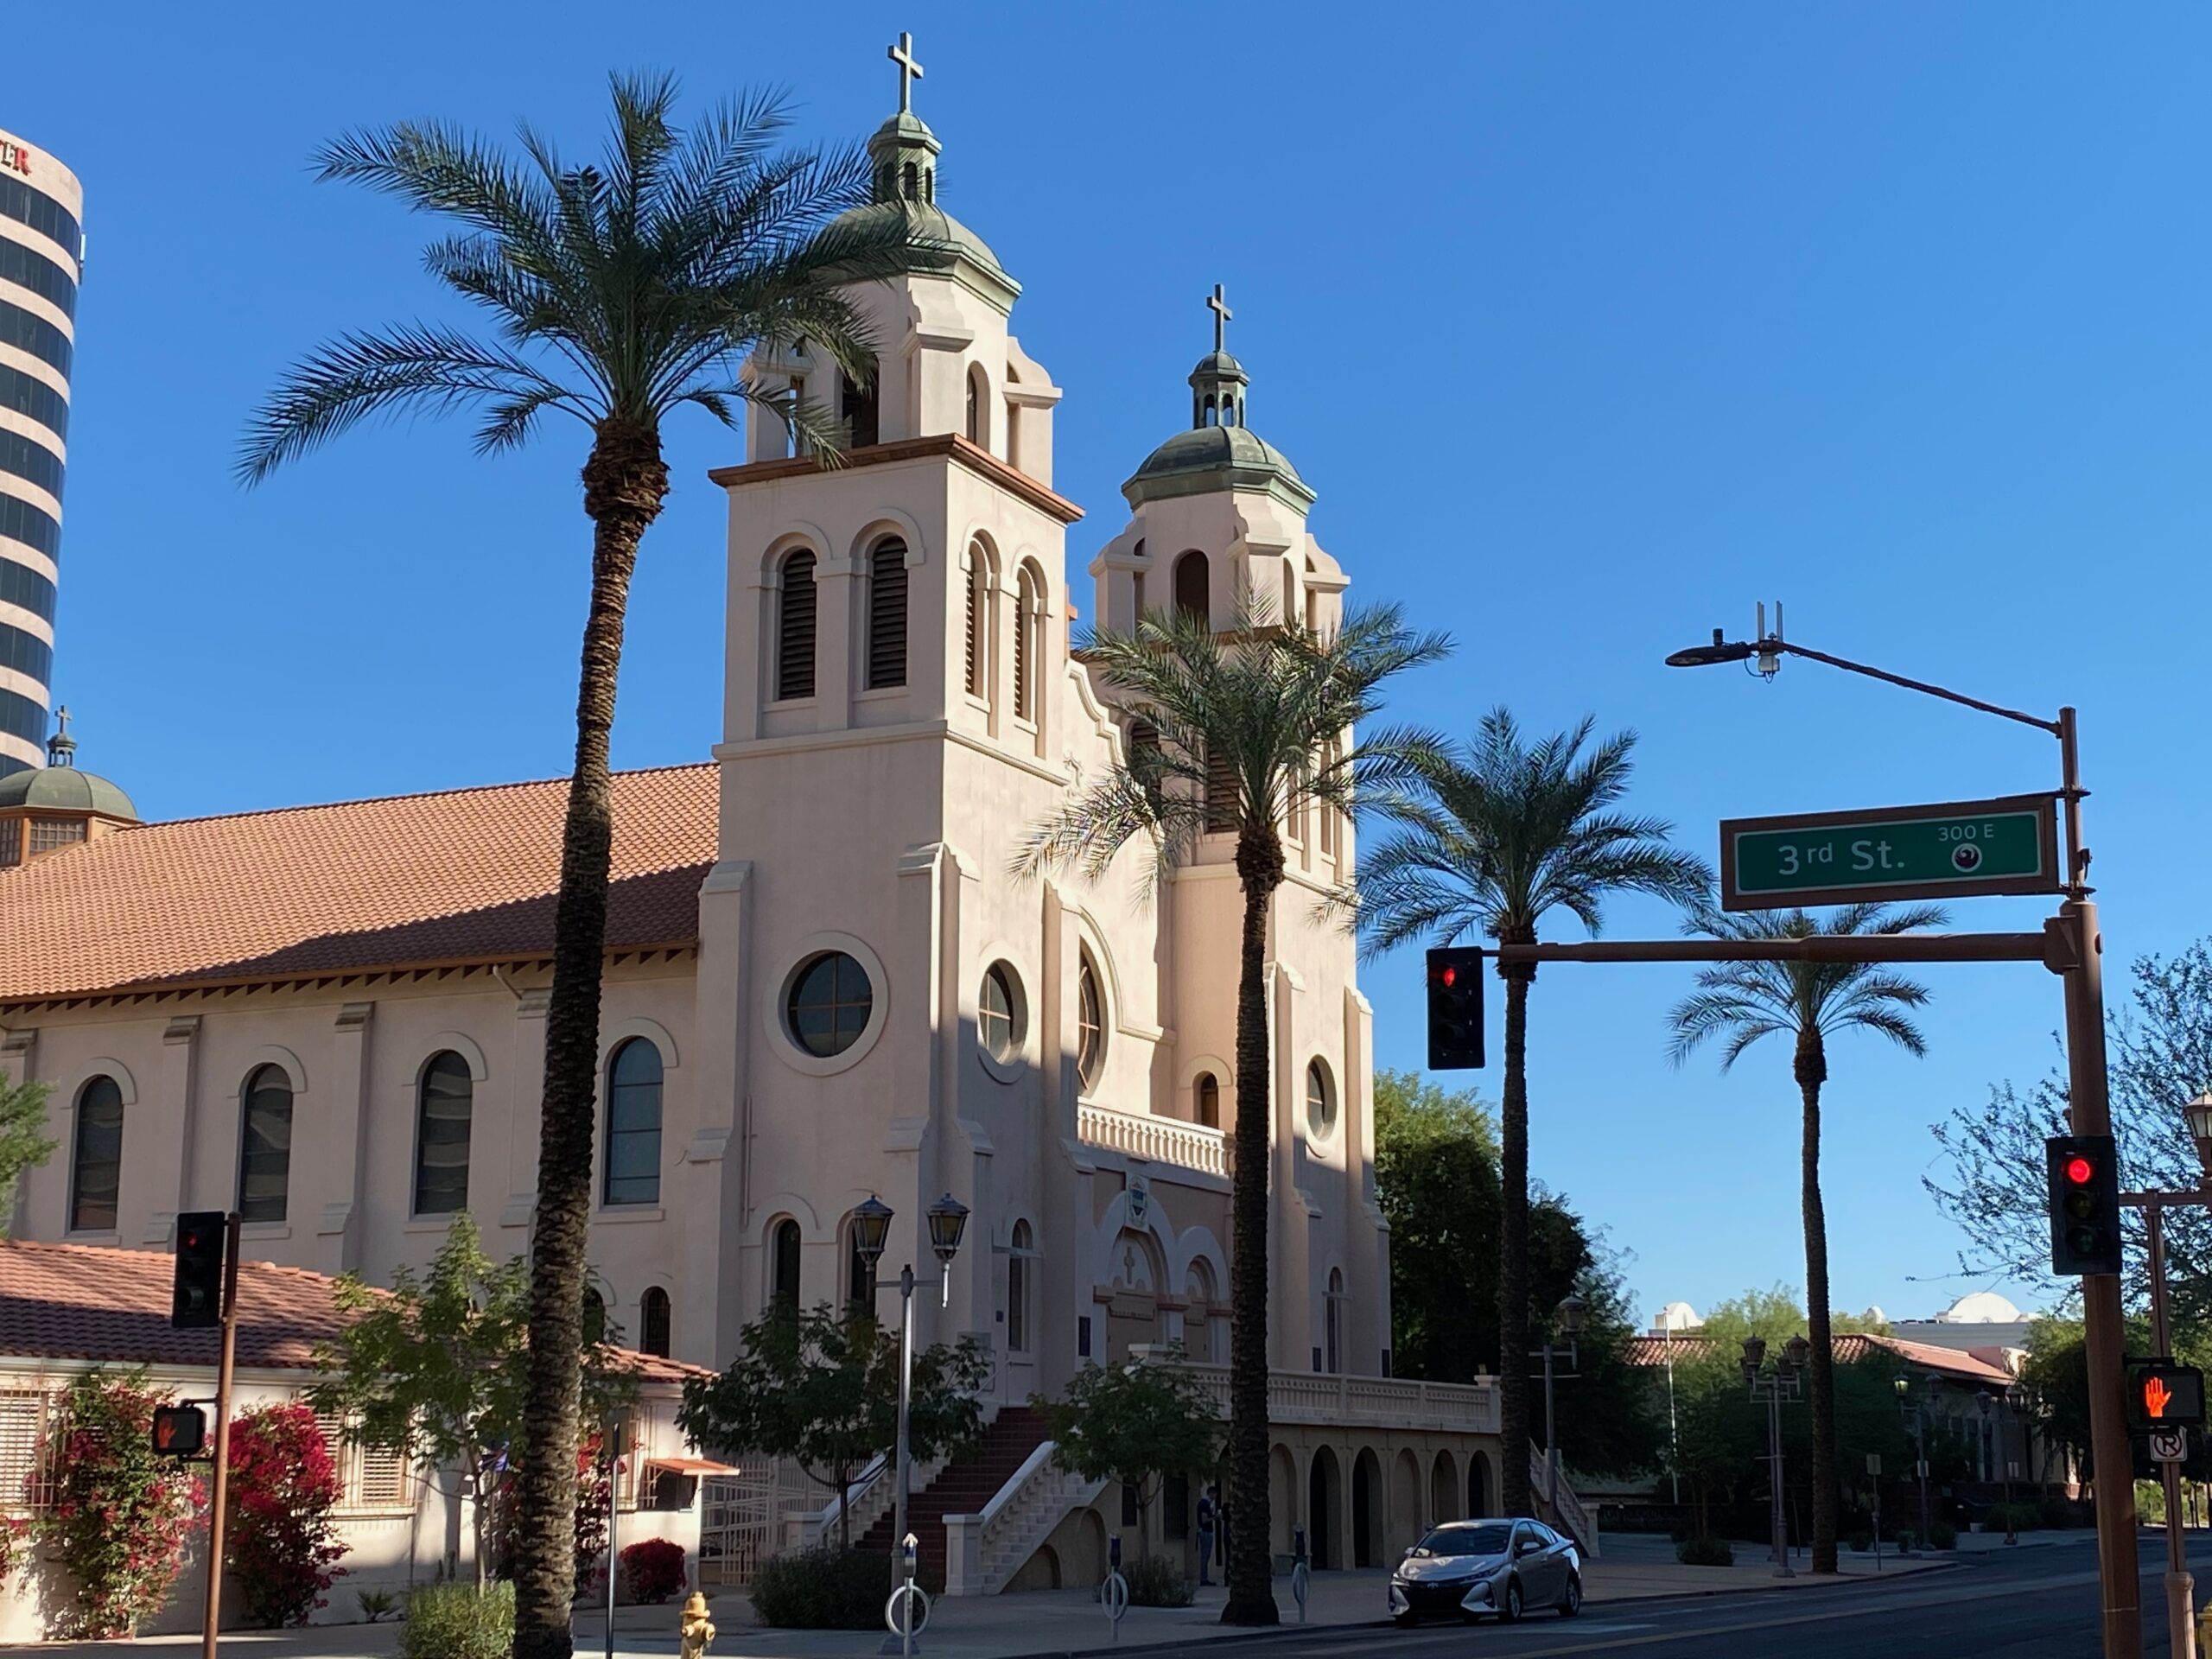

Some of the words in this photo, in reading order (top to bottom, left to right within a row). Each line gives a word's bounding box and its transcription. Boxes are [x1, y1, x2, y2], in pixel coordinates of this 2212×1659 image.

[1937, 824, 1977, 842] 300
[1983, 823, 1995, 839] E
[1777, 842, 1834, 876] 3rd
[1850, 839, 1905, 871] St.
